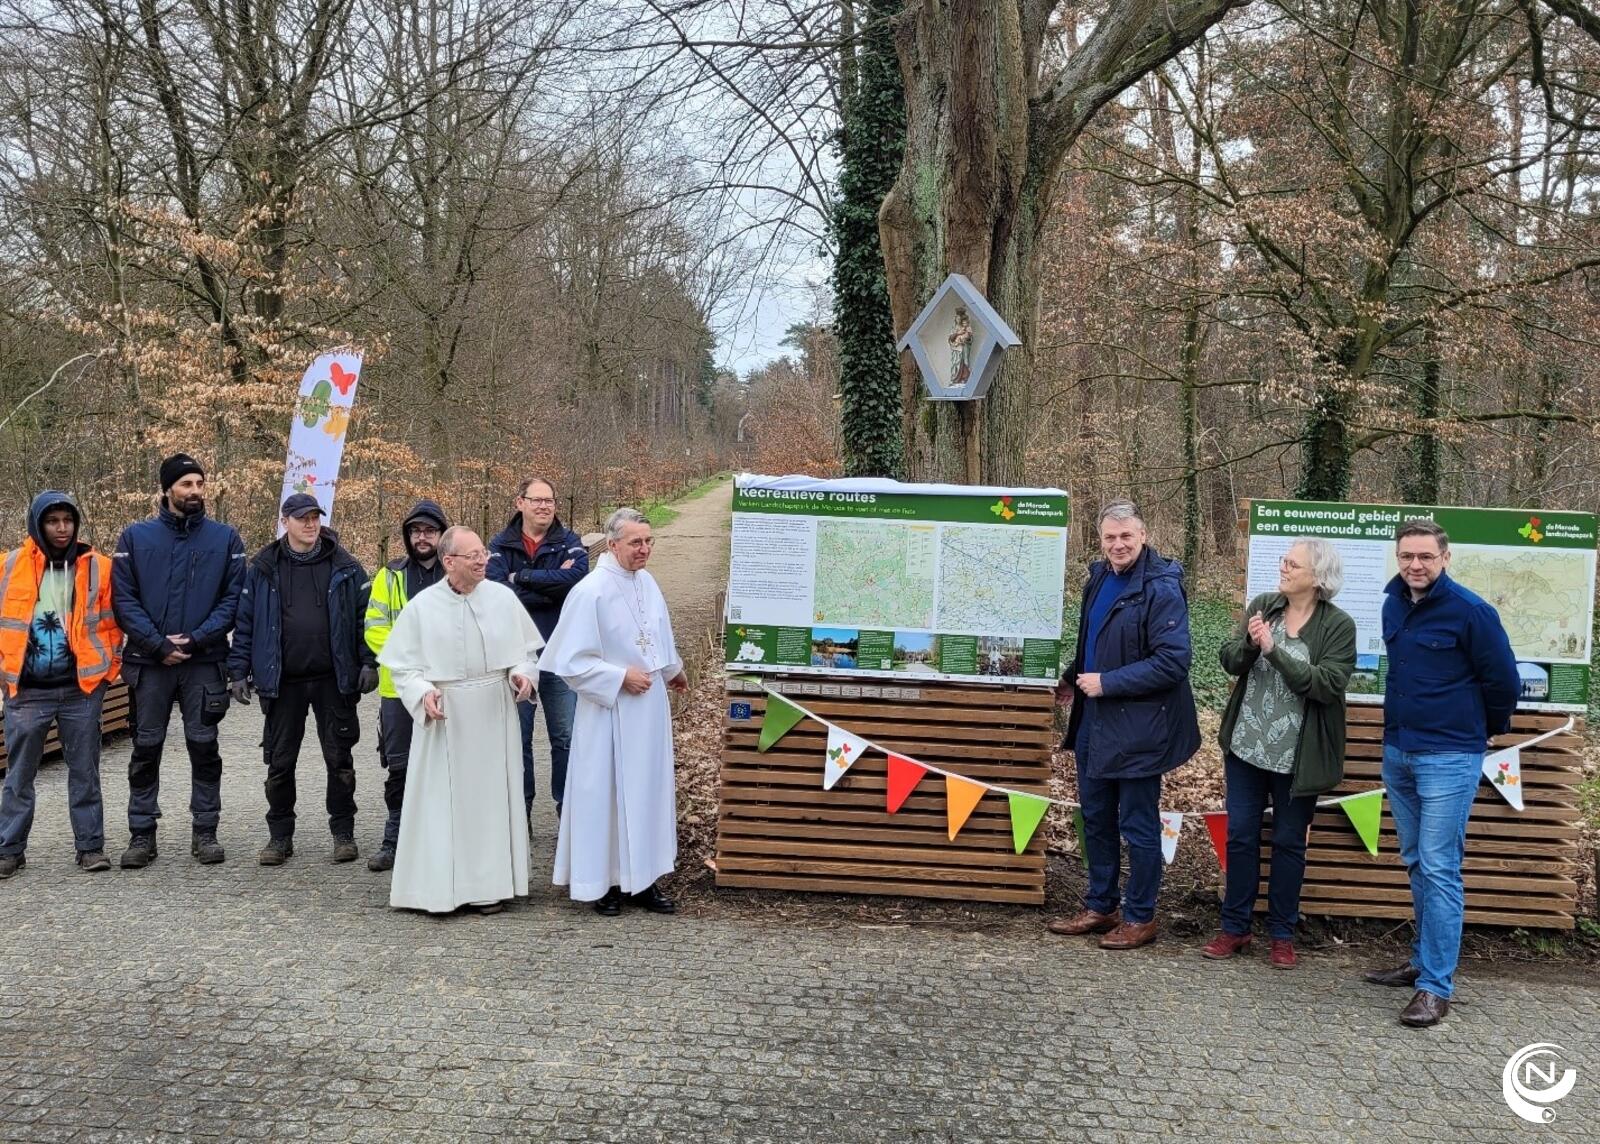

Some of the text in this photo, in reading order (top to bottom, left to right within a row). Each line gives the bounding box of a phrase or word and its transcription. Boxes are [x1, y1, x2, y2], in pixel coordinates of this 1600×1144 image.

[739, 487, 877, 503] Recreatieve routes
[1017, 508, 1063, 516] landschapspark
[1257, 505, 1280, 517] Een
[1283, 506, 1355, 520] eeuwenoud
[1358, 509, 1400, 523] gebied
[1256, 522, 1396, 539] een eeuwenoude abdij
[1545, 530, 1593, 538] landschapspark
